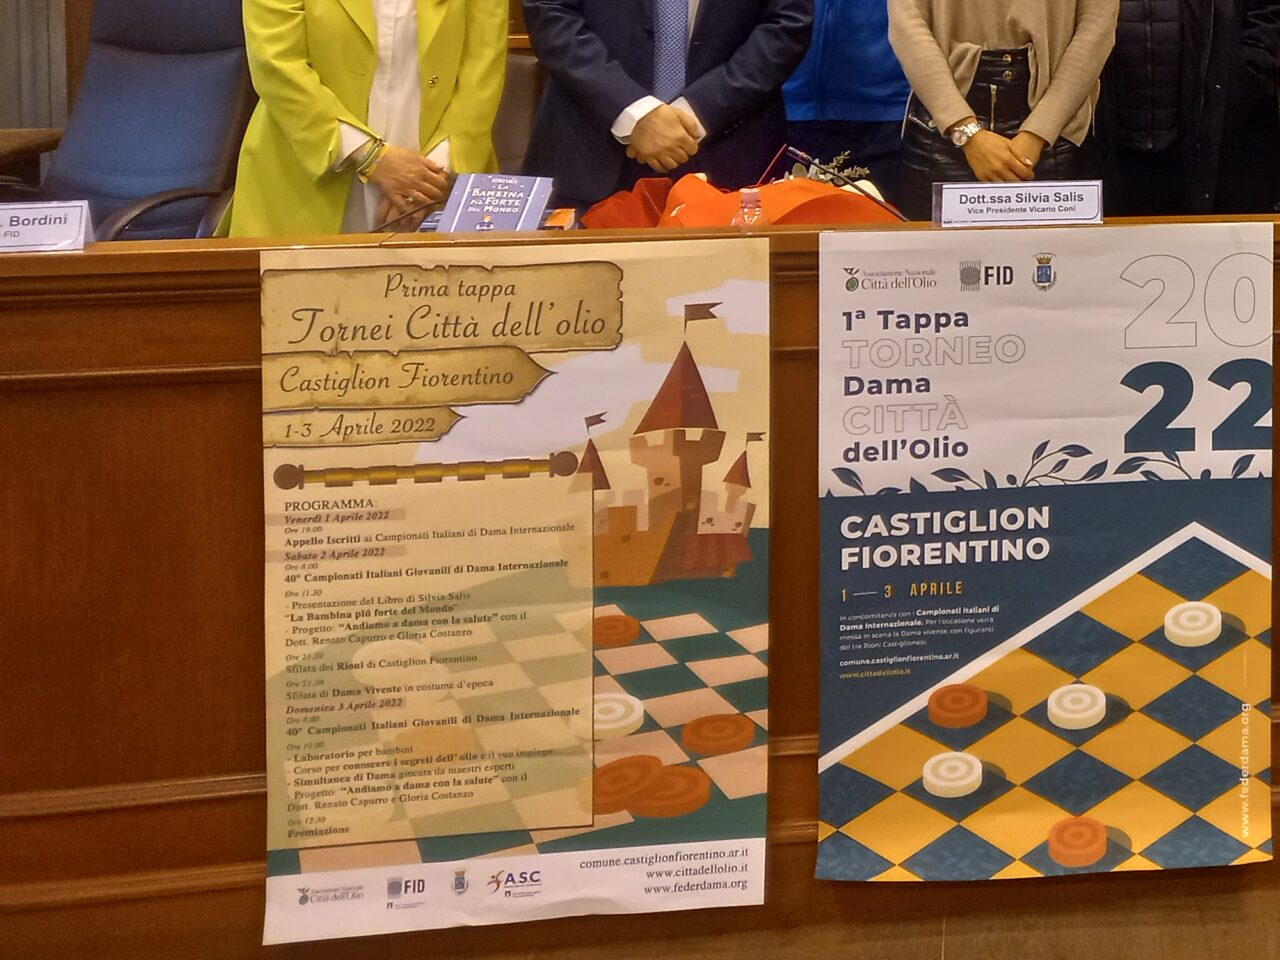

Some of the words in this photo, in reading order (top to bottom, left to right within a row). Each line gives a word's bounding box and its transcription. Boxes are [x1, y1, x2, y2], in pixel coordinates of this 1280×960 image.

[471, 188, 524, 198] BAMBINA
[484, 196, 522, 206] FORTE
[959, 194, 1012, 204] Dott.ssa
[1015, 192, 1050, 204] Silvia
[1053, 192, 1084, 202] Salis
[483, 205, 519, 213] MONDO
[986, 206, 1028, 214] Presidente
[10, 214, 68, 227] Bordini
[4, 230, 20, 238] FID
[860, 276, 888, 290] Città
[890, 276, 938, 289] dell'Olio
[984, 266, 1014, 286] FID
[383, 271, 449, 299] Prima
[457, 278, 516, 303] tappa
[1119, 252, 1273, 350] 20
[287, 305, 394, 345] Tornei
[405, 303, 481, 341] Città
[877, 310, 970, 334] Tappa
[842, 334, 1026, 369] TORNEO
[279, 363, 392, 398] Castiglion
[398, 362, 515, 391] Fiorentino
[843, 375, 931, 397] Dama
[1120, 358, 1273, 454] 22
[842, 394, 968, 436] CITTÀ
[284, 421, 313, 438] 1-3
[318, 412, 385, 442] Aprile
[390, 416, 436, 436] 2022
[284, 499, 379, 512] PROGRAMMA:
[284, 514, 322, 524] Venerdì
[332, 512, 364, 524] Aprile
[366, 511, 390, 520] 2022
[840, 506, 1050, 540] CASTIGLION
[284, 538, 324, 548] Appello
[327, 535, 361, 544] Iscritti
[375, 532, 429, 542] Campionati
[432, 530, 465, 539] Italiani
[468, 528, 477, 537] di
[480, 528, 507, 536] Dama
[510, 524, 576, 535] Internazionale
[284, 551, 318, 562] Sabato
[330, 550, 360, 560] Aprile
[362, 548, 386, 557] 2022
[840, 536, 1050, 571] FIORENTINO
[304, 570, 363, 583] Campionati
[366, 568, 402, 579] Italiani
[406, 566, 451, 576] Giovanili
[454, 565, 464, 574] di
[466, 564, 494, 572] Dama
[498, 559, 568, 572] Internazionale
[841, 588, 848, 602] 1
[884, 584, 893, 598] 3
[910, 581, 964, 597] APRILE
[292, 600, 357, 610] Presentazione
[360, 597, 374, 606] del
[378, 596, 404, 604] Libro
[418, 594, 445, 602] Silvia
[307, 611, 352, 621] Bambina
[374, 608, 398, 618] forte
[401, 606, 416, 615] del
[916, 608, 962, 620] Campionati
[963, 606, 990, 614] Italiani
[402, 618, 429, 628] dama
[432, 618, 449, 626] con
[840, 623, 864, 632] Dama
[312, 637, 346, 646] Renato
[348, 634, 387, 644] Capurro
[397, 630, 427, 640] Gloria
[430, 628, 473, 638] Costanzo
[336, 661, 364, 671] Rioni
[378, 658, 427, 668] Castiglion
[429, 655, 478, 665] Fiorentino
[840, 652, 960, 667] comune.castiglionfiorentino.ar.it
[332, 688, 362, 697] Dama
[364, 686, 402, 695] Vivente
[416, 682, 454, 692] costume
[286, 704, 335, 715] Domenica
[345, 700, 377, 712] Aprile
[378, 698, 402, 708] 2022
[307, 722, 366, 735] Campionati
[371, 720, 408, 730] Italiani
[412, 717, 458, 728] Giovanili
[462, 715, 472, 724] di
[476, 714, 506, 723] Dama
[510, 708, 580, 720] Internazionale
[294, 750, 356, 763] Laboratorio
[358, 750, 373, 760] per
[376, 746, 414, 756] bambini
[294, 766, 322, 775] Corso
[324, 765, 340, 774] per
[342, 761, 392, 770] conoscere
[400, 756, 433, 766] segreti
[1239, 702, 1252, 838] www.federdama.org
[294, 776, 350, 787] Simultanea
[353, 773, 363, 782] di
[366, 772, 396, 780] Dama
[448, 764, 482, 774] maestri
[484, 763, 515, 772] esperti
[403, 781, 430, 790] dama
[433, 780, 450, 788] con
[314, 800, 348, 810] Renato
[350, 796, 388, 808] Capurro
[400, 794, 428, 802] Gloria
[431, 790, 474, 800] Costanzo
[288, 826, 350, 838] Premiazione
[580, 848, 749, 869] comune.castiglionfiorentino.ar.it
[646, 862, 748, 879] www.cittadellolio.it
[404, 878, 426, 895] FID
[644, 879, 748, 895] www.federdama.org
